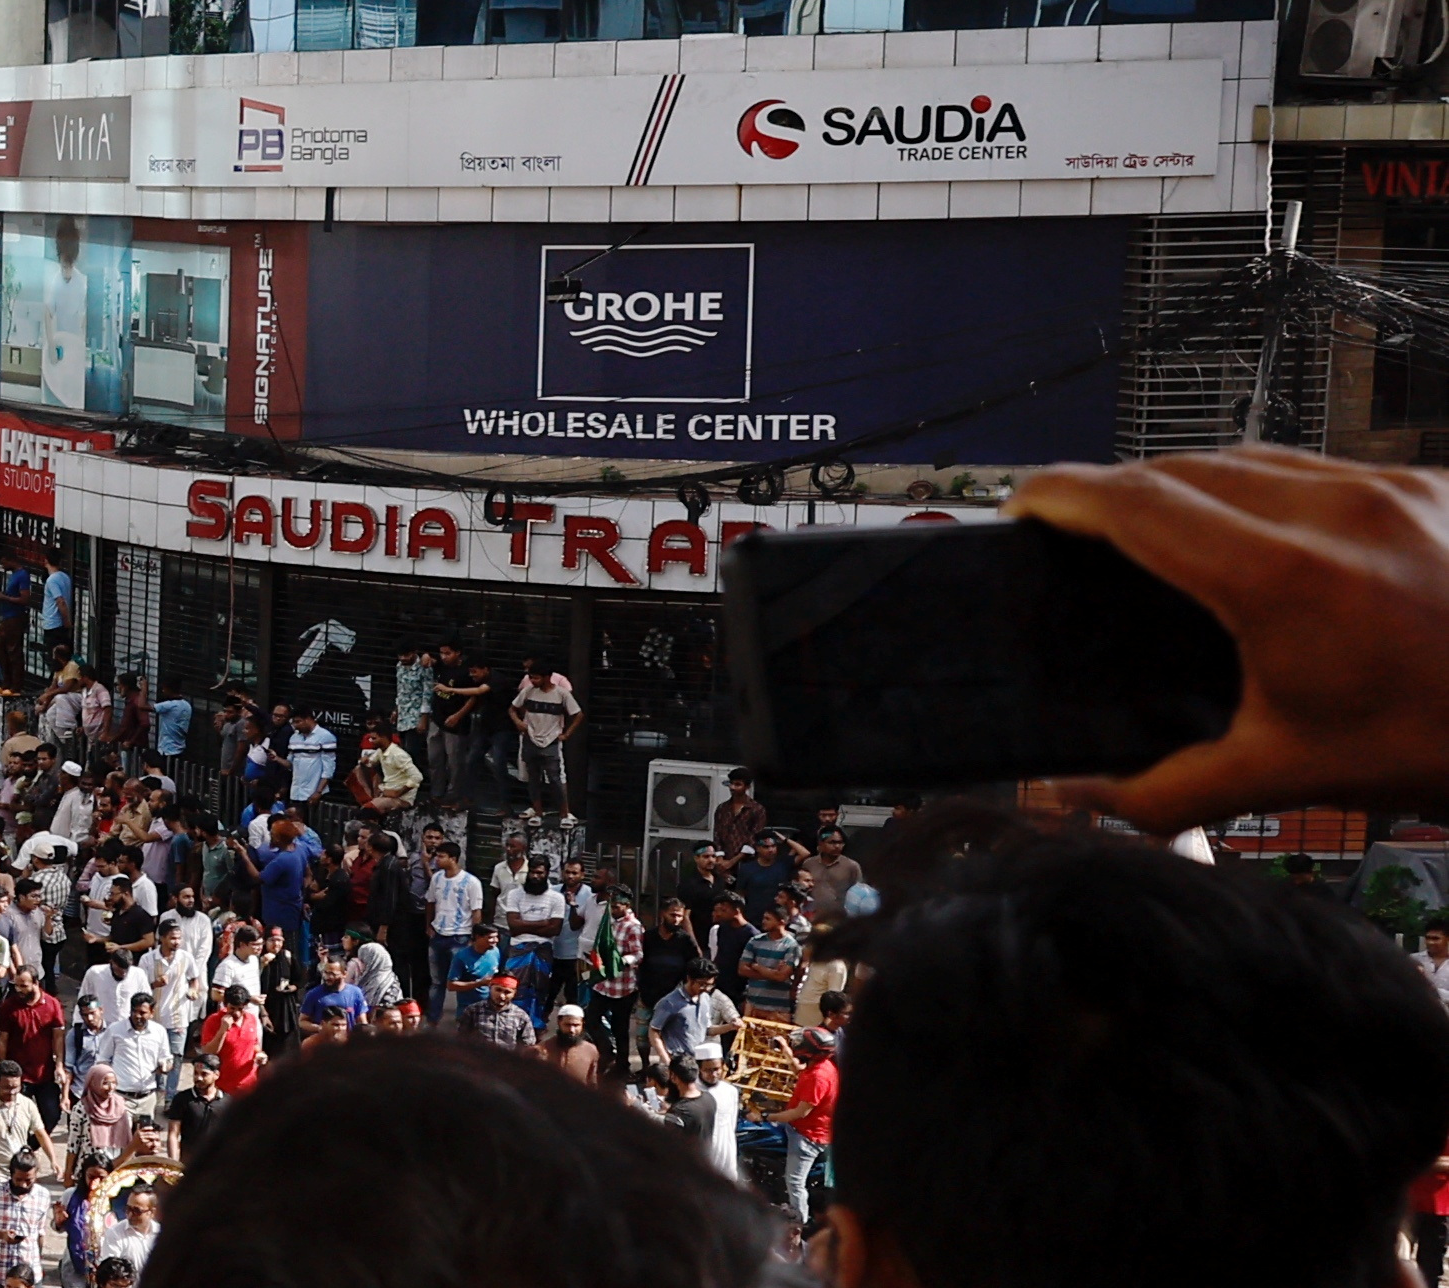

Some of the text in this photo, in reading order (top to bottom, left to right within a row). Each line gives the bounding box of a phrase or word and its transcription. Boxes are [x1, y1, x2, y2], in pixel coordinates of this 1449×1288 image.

[53, 113, 112, 162] VitrA
[237, 129, 285, 161] PB
[291, 127, 368, 144] Priotoma
[291, 145, 350, 165] Bangla
[460, 152, 561, 172] প্রিয়তমা বাংলা
[897, 145, 1027, 162] TRADE CENTER
[563, 291, 724, 322] GROHE
[254, 248, 273, 425] SIGNATURE
[463, 408, 837, 442] WHOLESALE CENTER
[3, 468, 42, 494] STUDIO
[186, 479, 460, 563] SAUDIA
